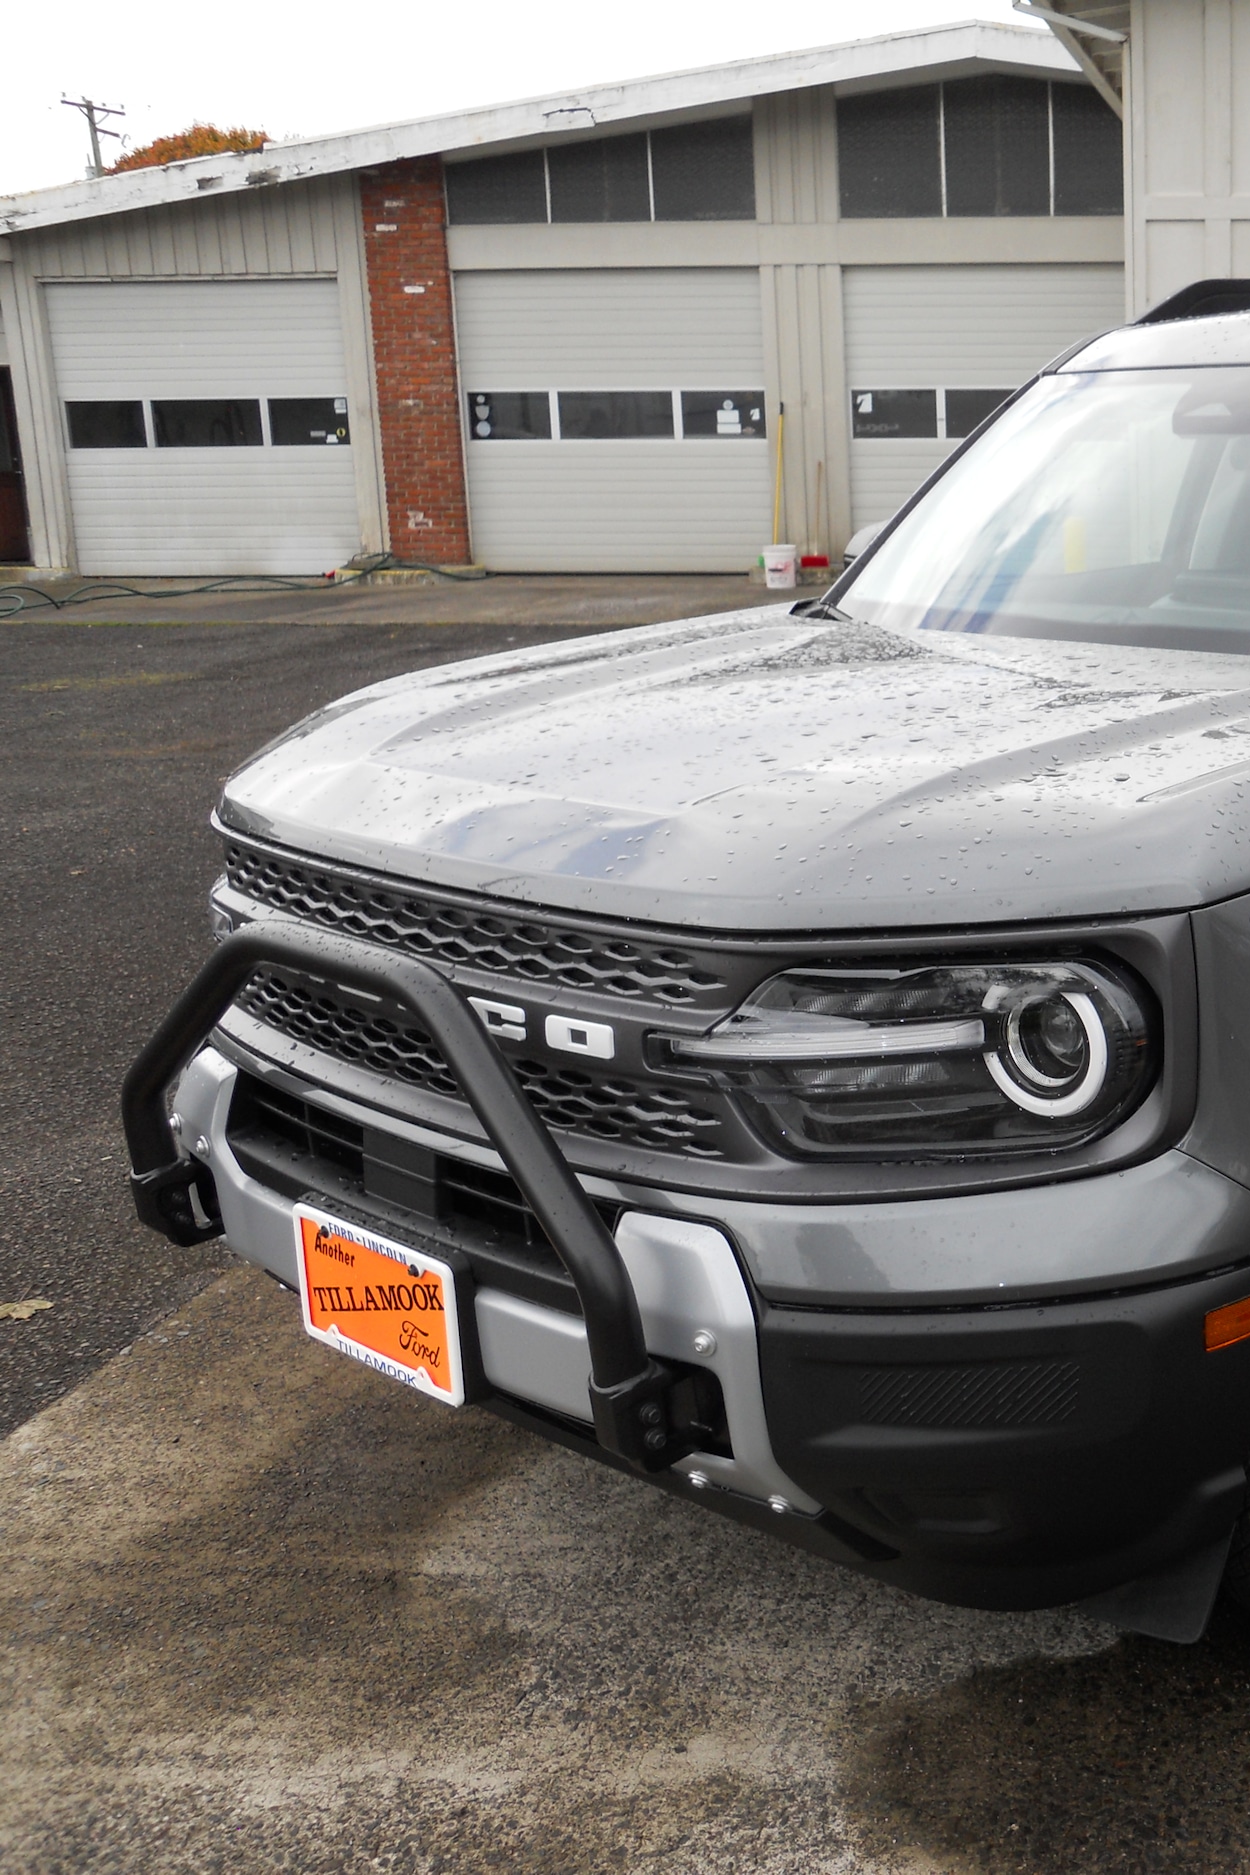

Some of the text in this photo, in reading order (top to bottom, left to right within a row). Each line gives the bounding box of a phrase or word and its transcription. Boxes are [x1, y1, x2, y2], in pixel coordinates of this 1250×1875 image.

[314, 1231, 356, 1268] Another
[328, 1222, 408, 1266] FORD LINCOLN
[313, 1284, 445, 1312] TILLAMOOK
[337, 1338, 417, 1387] TILLAMOOK
[400, 1320, 441, 1368] Ford
